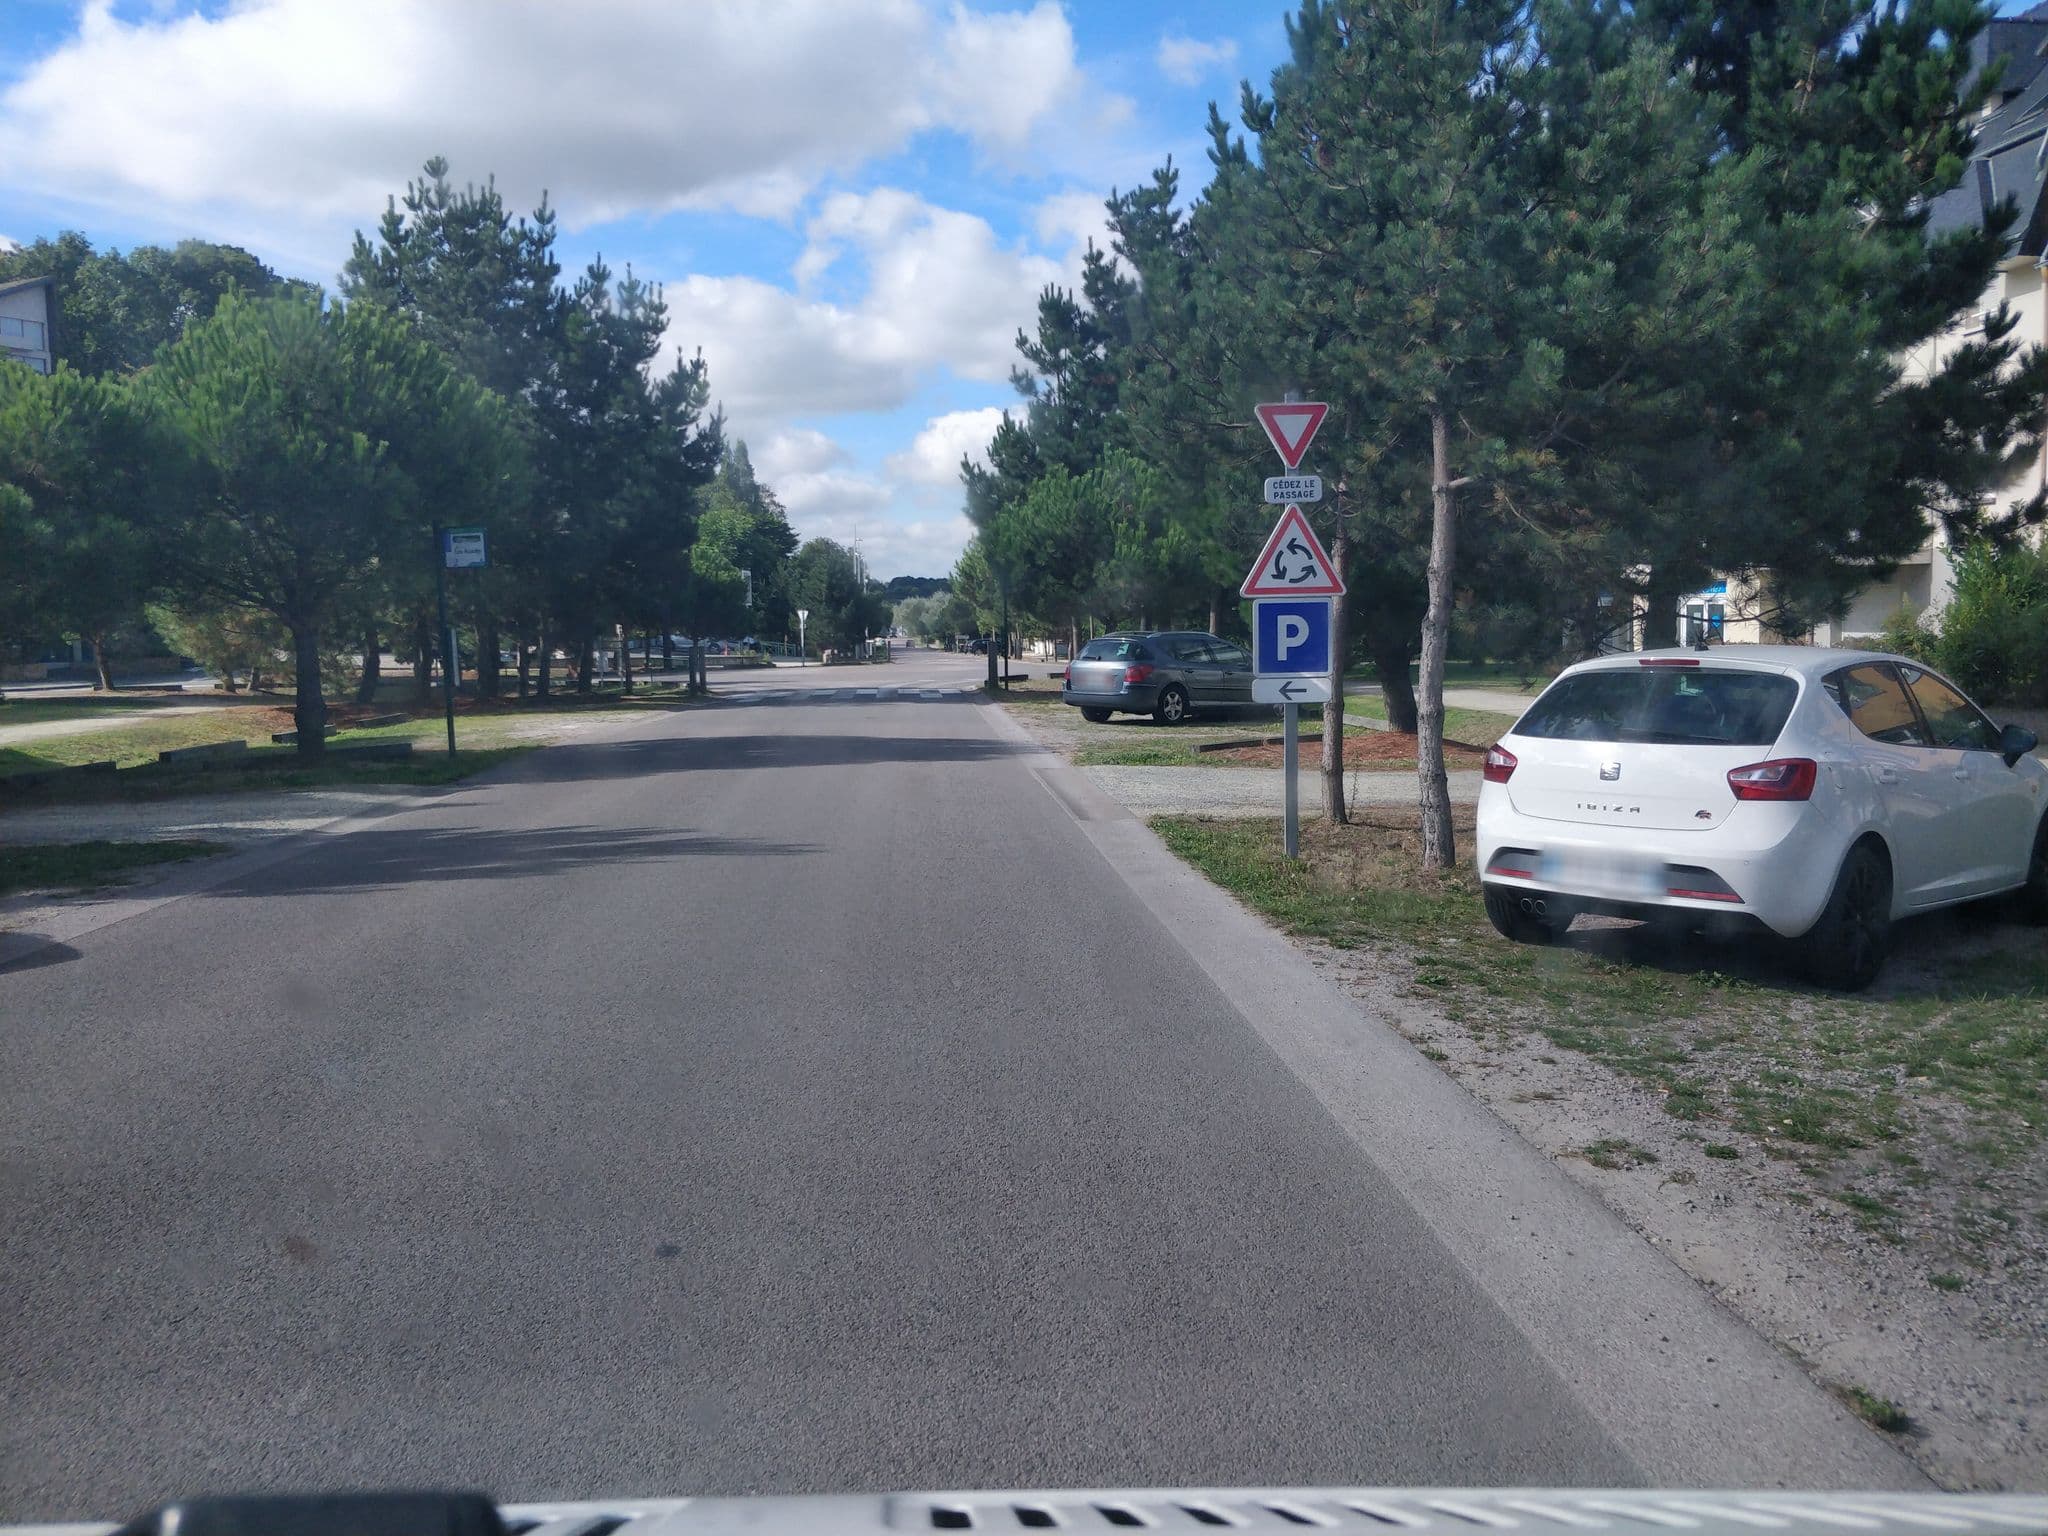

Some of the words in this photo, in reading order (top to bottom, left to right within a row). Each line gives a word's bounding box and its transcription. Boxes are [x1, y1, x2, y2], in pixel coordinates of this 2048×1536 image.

[1273, 480, 1300, 489] CÉDEZ
[1304, 480, 1315, 488] LE
[1273, 490, 1315, 499] PASSAGE
[1277, 615, 1309, 661] P
[1577, 803, 1640, 813] IBIZA
